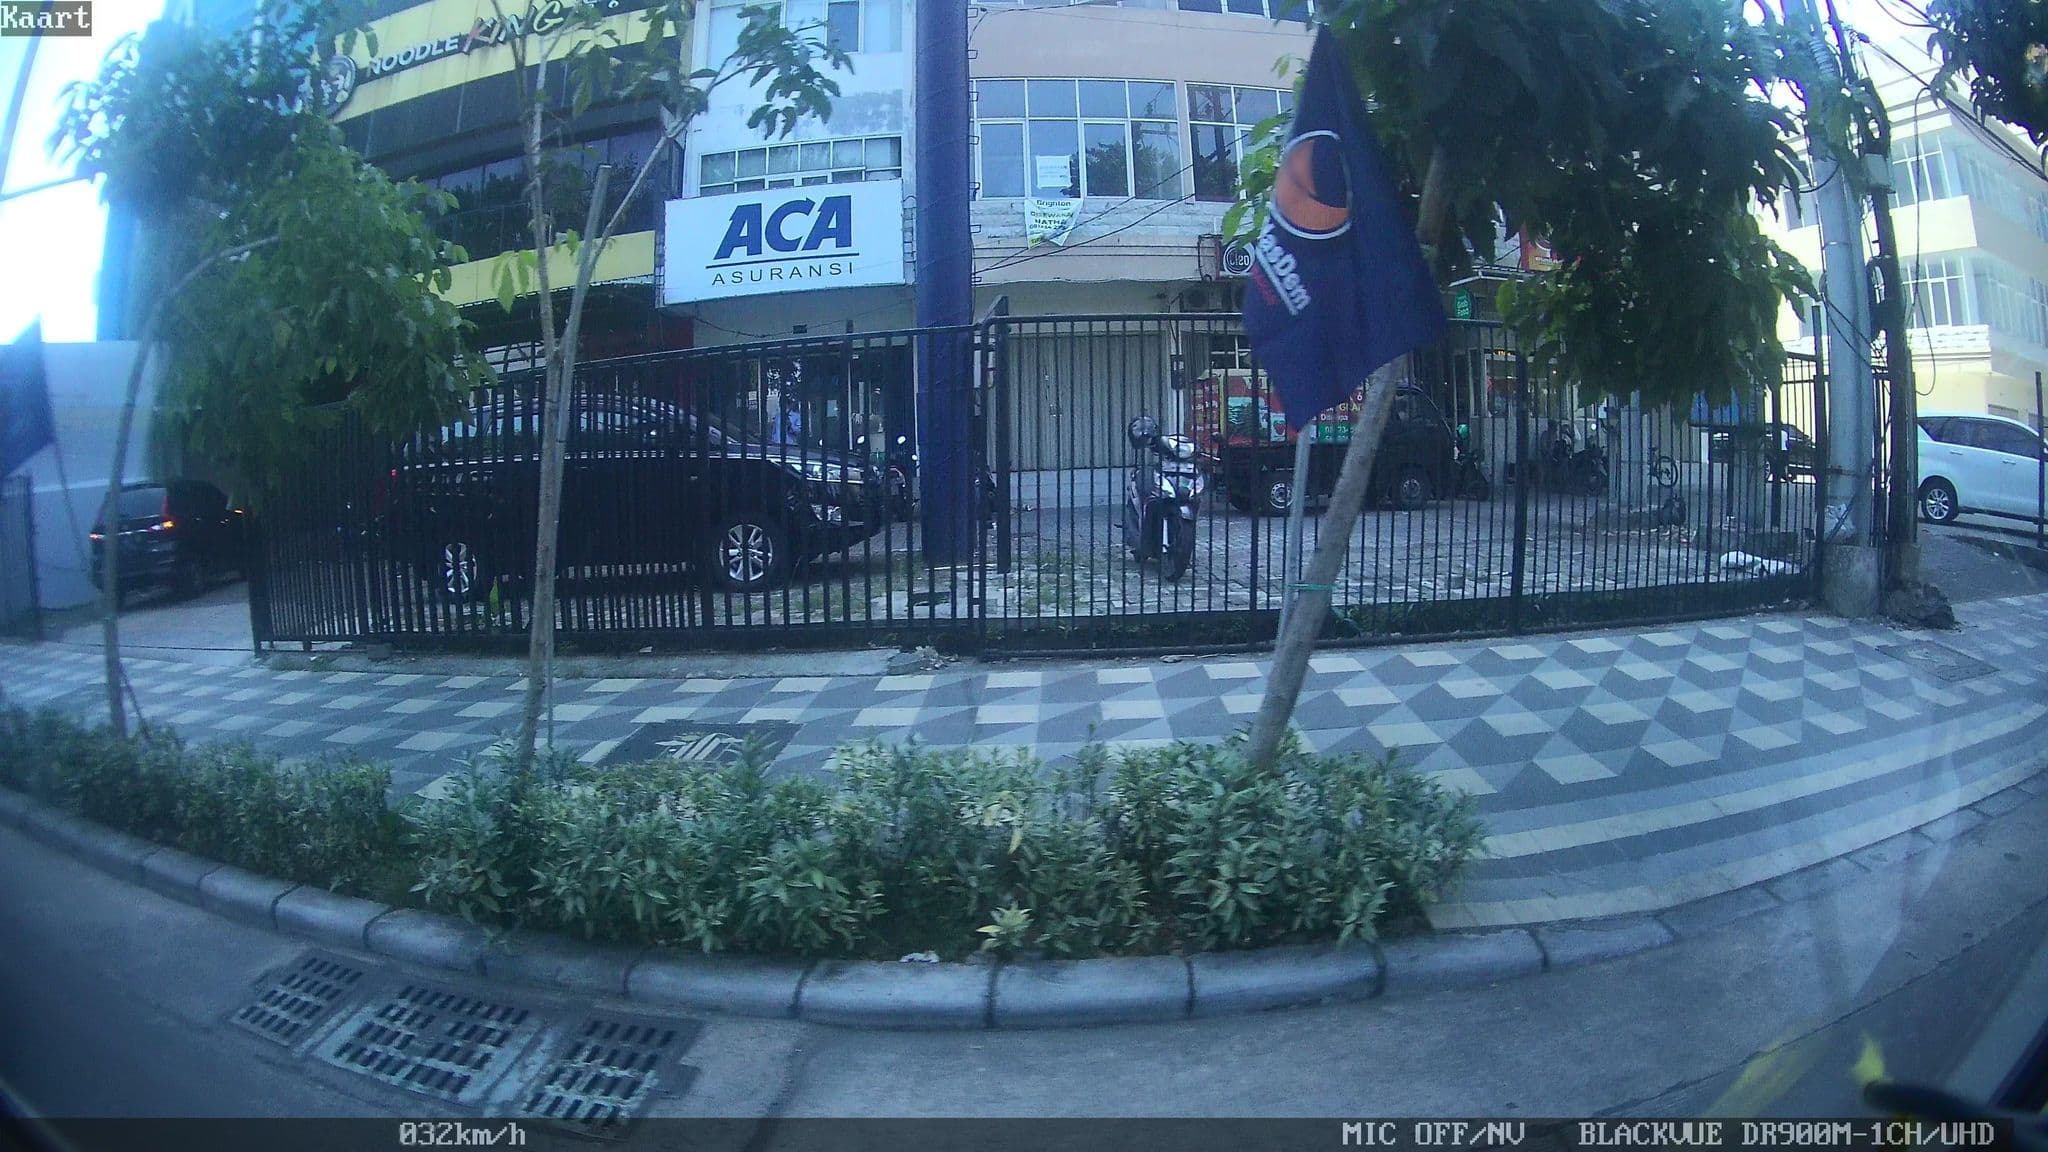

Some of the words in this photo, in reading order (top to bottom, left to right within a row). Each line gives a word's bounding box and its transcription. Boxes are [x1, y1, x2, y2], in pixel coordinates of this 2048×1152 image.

[366, 38, 459, 77] NOODLE
[463, 0, 564, 53] KING
[713, 195, 852, 260] ACA
[712, 262, 853, 286] ASURANSI
